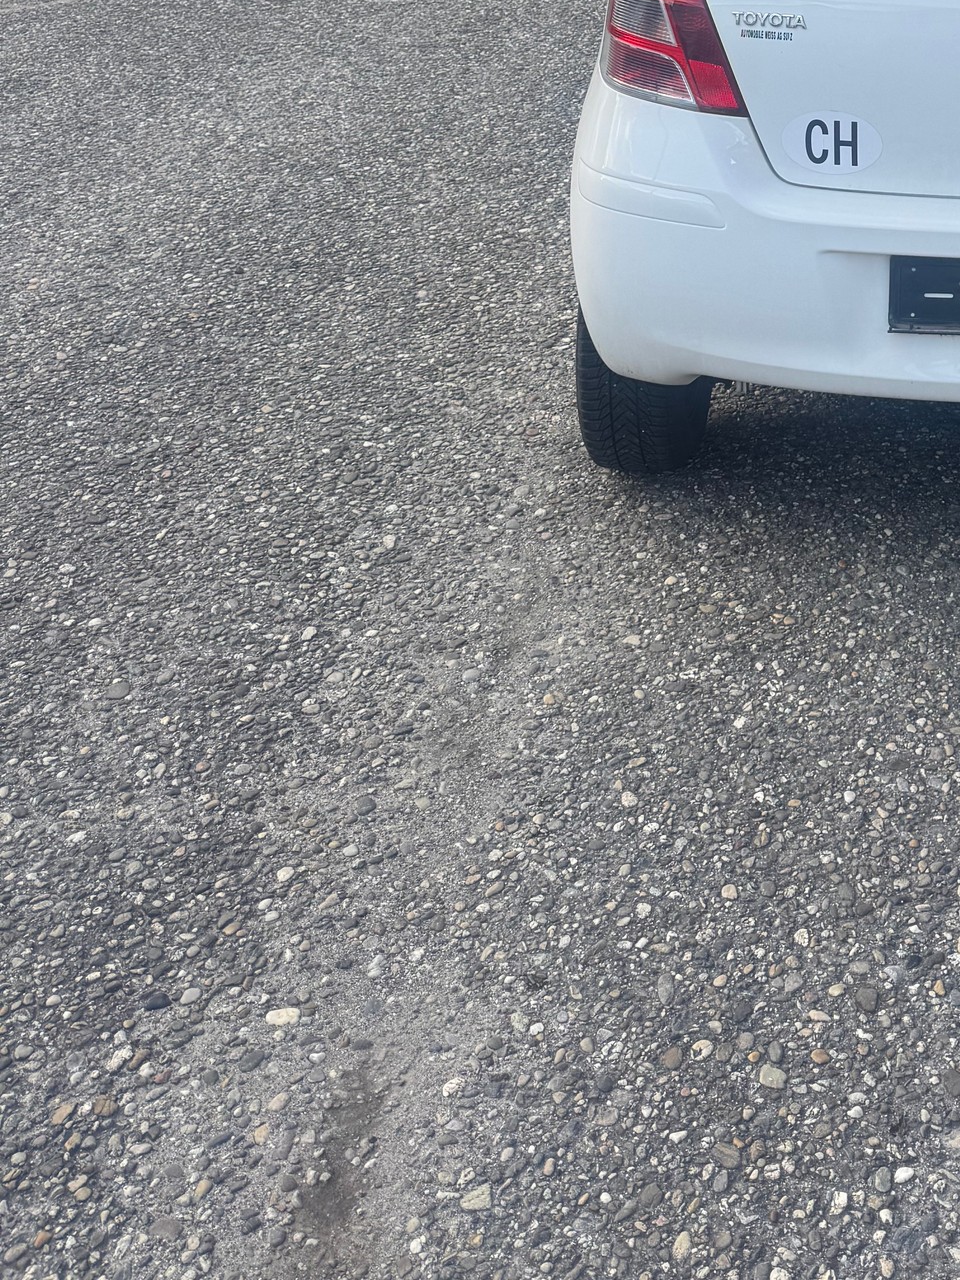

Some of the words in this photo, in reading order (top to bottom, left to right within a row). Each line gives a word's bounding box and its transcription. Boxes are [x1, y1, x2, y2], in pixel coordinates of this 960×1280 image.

[731, 10, 808, 30] TOYOTA
[740, 29, 764, 39] AUTOMOBILE
[765, 31, 776, 40] WEISS
[777, 32, 782, 41] AG
[804, 119, 858, 166] CH
